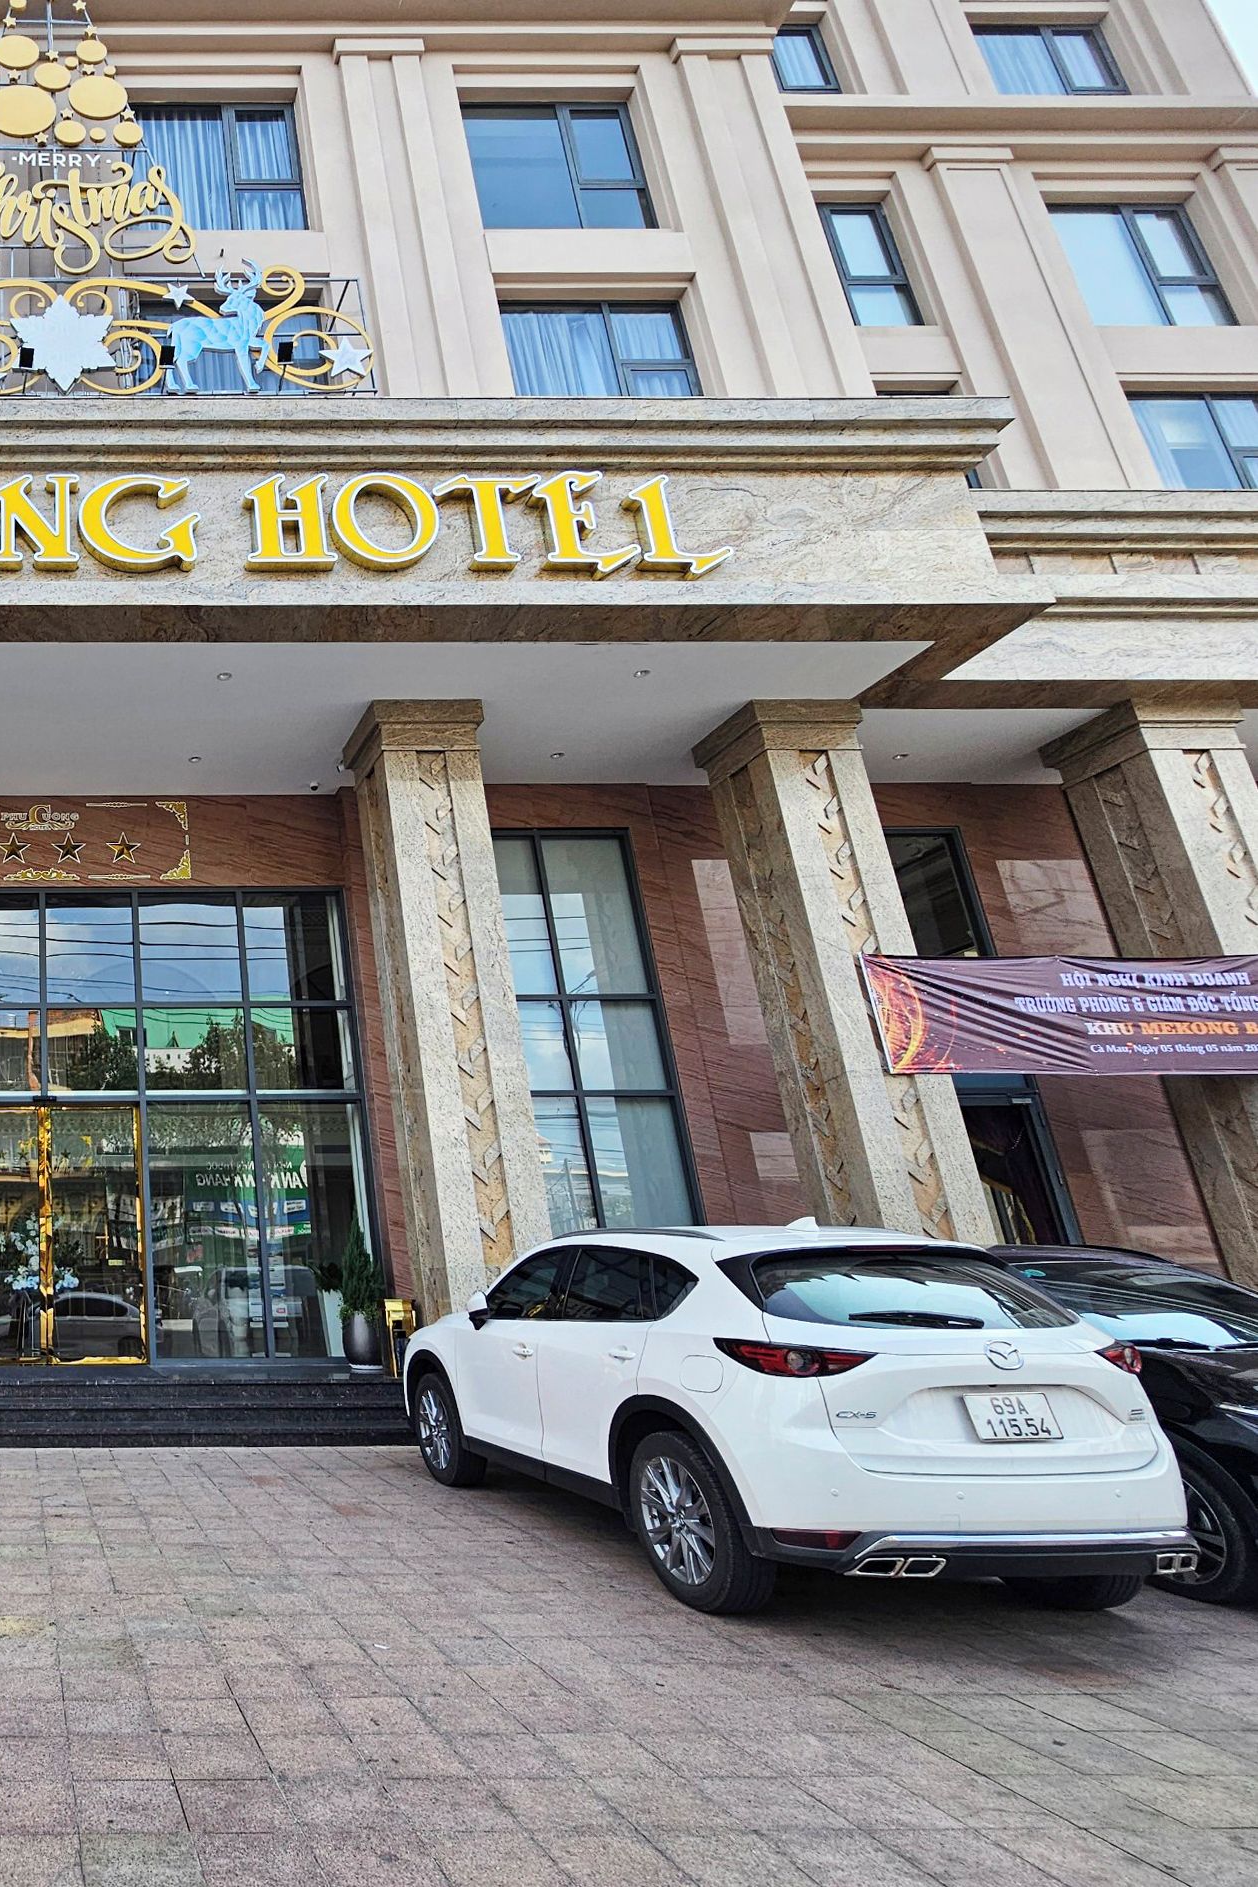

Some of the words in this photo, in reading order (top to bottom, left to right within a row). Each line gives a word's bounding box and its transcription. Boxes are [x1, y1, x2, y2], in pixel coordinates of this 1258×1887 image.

[18, 152, 101, 167] MERRY
[243, 470, 733, 582] HOTEL
[1, 812, 28, 821] PHU
[1060, 971, 1092, 989] HỘI
[1094, 973, 1140, 989] NGHỊ
[1142, 973, 1188, 987] KINH
[1189, 972, 1251, 986] DOANH
[1077, 993, 1131, 1013] PHÒNG
[1132, 996, 1145, 1012] &
[1146, 994, 1186, 1012] GIÁM
[1186, 992, 1219, 1012] ĐỐC
[1084, 1022, 1135, 1036] KHU
[1139, 1021, 1240, 1035] MEKONG
[1090, 1044, 1105, 1053] Cà
[1134, 1044, 1159, 1055] Ngày
[1160, 1045, 1174, 1053] 05
[1175, 1044, 1206, 1055] tháng
[1206, 1044, 1219, 1053] 05
[1220, 1044, 1244, 1053] năm
[990, 1396, 1029, 1415] 69A
[986, 1417, 1052, 1437] 115.54
